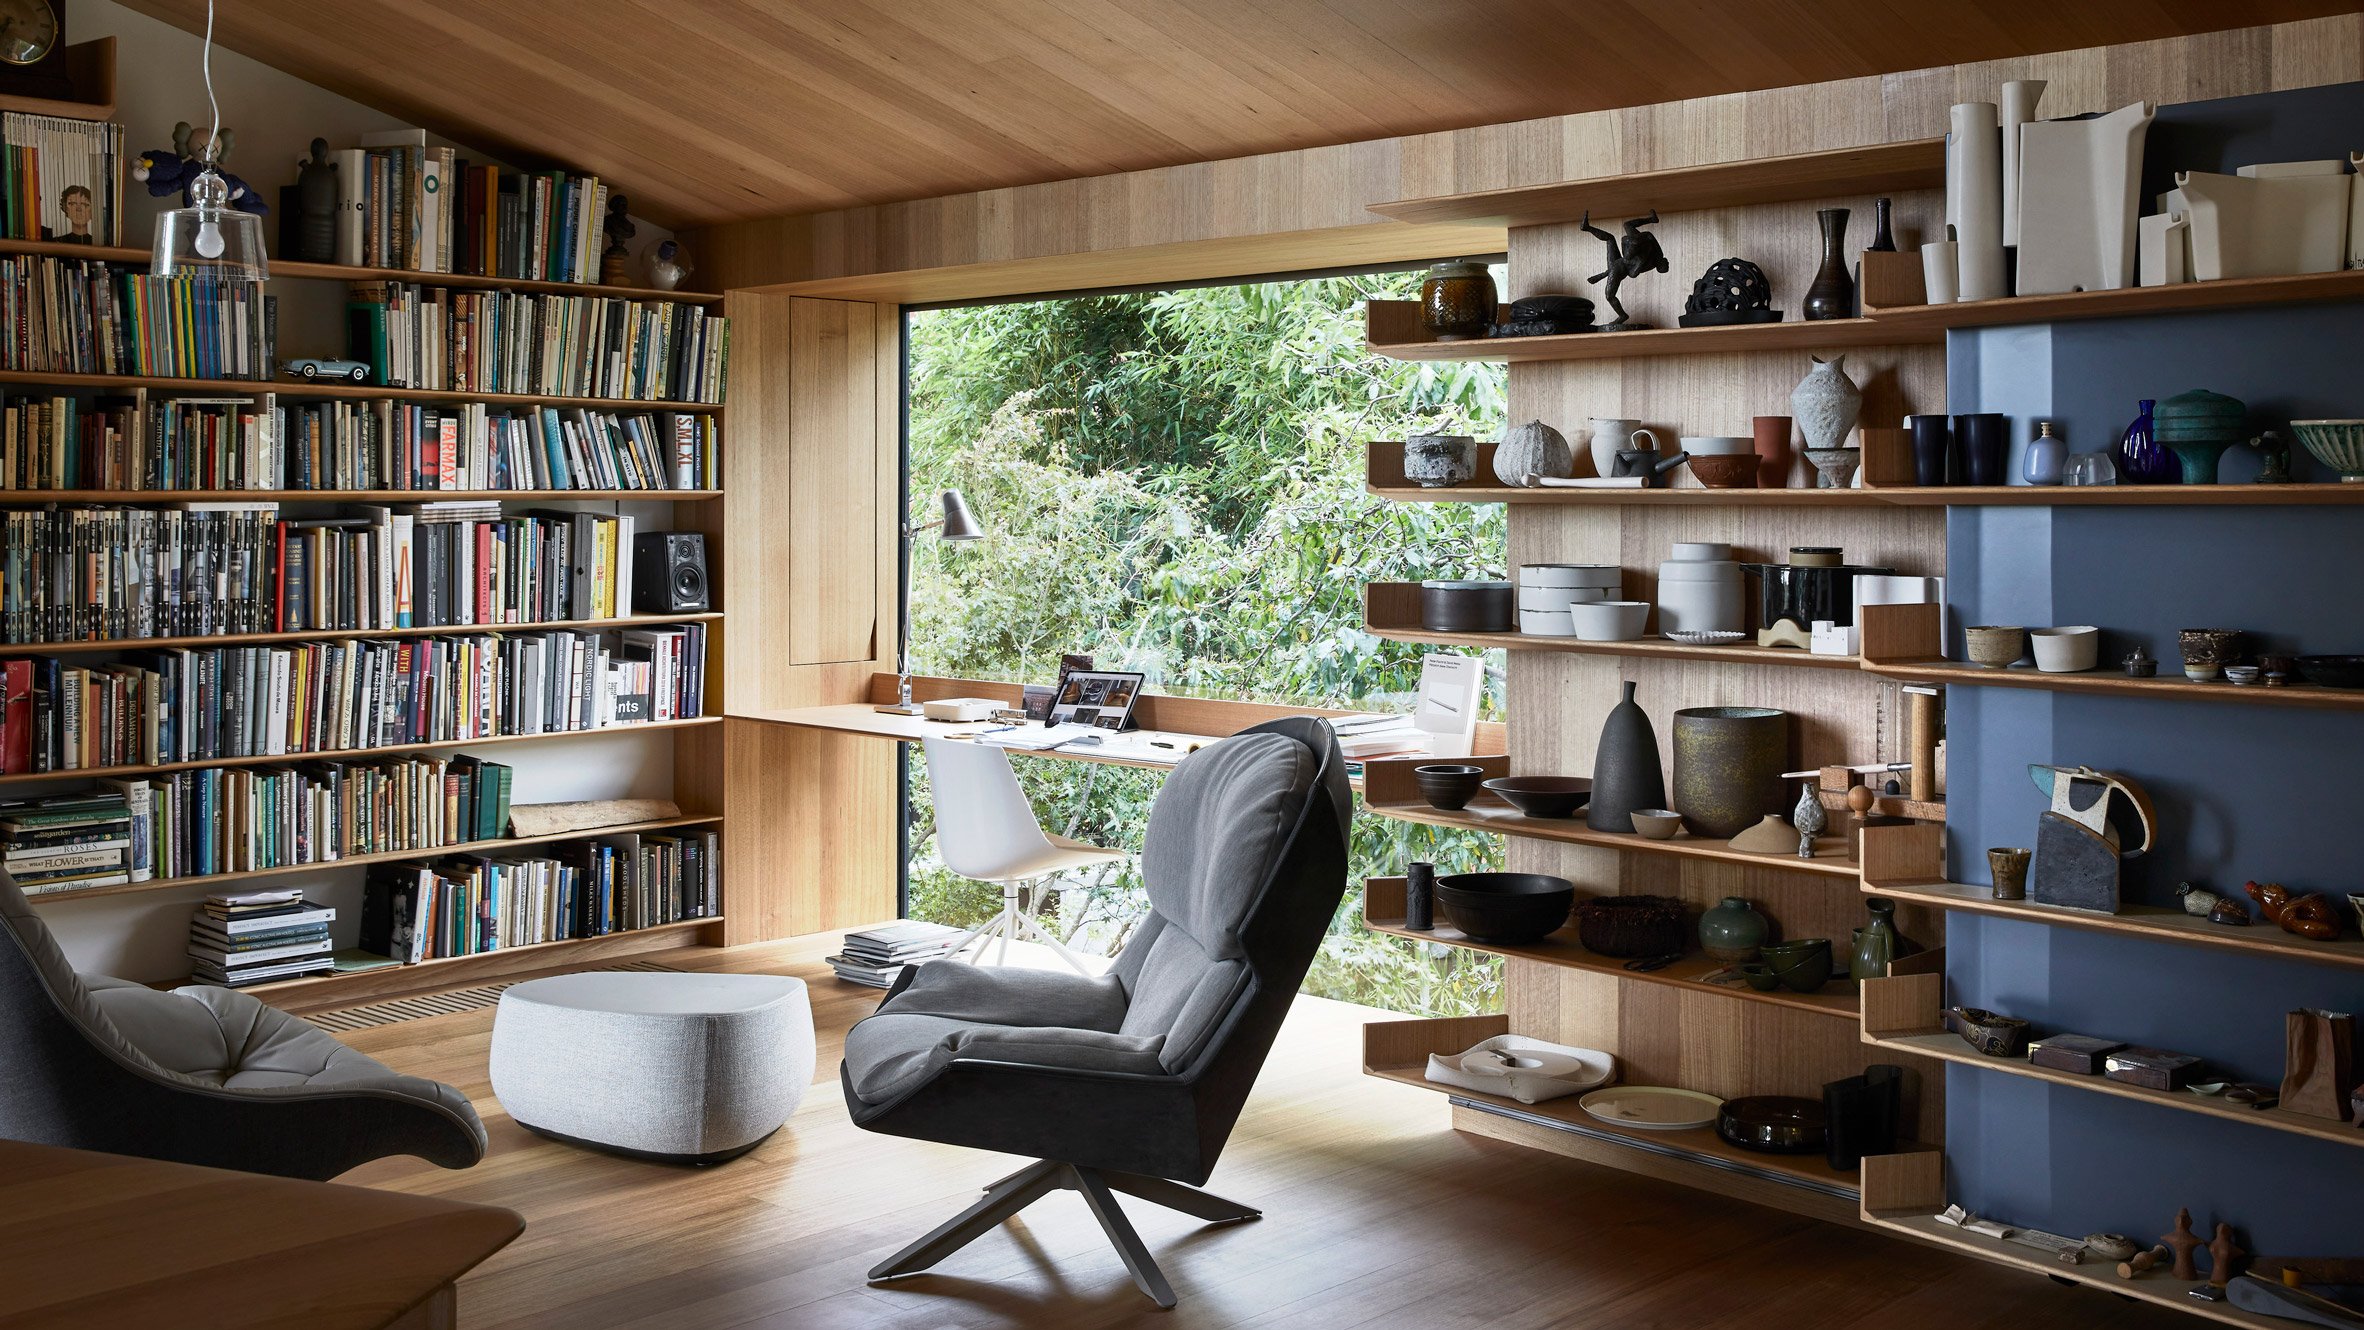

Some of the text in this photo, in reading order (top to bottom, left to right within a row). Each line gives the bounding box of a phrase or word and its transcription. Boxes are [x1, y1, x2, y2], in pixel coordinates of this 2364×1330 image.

[660, 303, 672, 363] CARLO SCARPA
[441, 425, 456, 485] FARMAX
[676, 417, 693, 469] S,M,L,XL
[399, 649, 410, 672] WITH
[584, 648, 594, 701] NORDIC LIGHT
[65, 679, 73, 732] MILLENNIUM
[44, 856, 85, 868] FLOWER
[63, 843, 98, 853] ROSES
[39, 881, 93, 894] Visions of Paradise
[641, 852, 649, 890] Homestead
